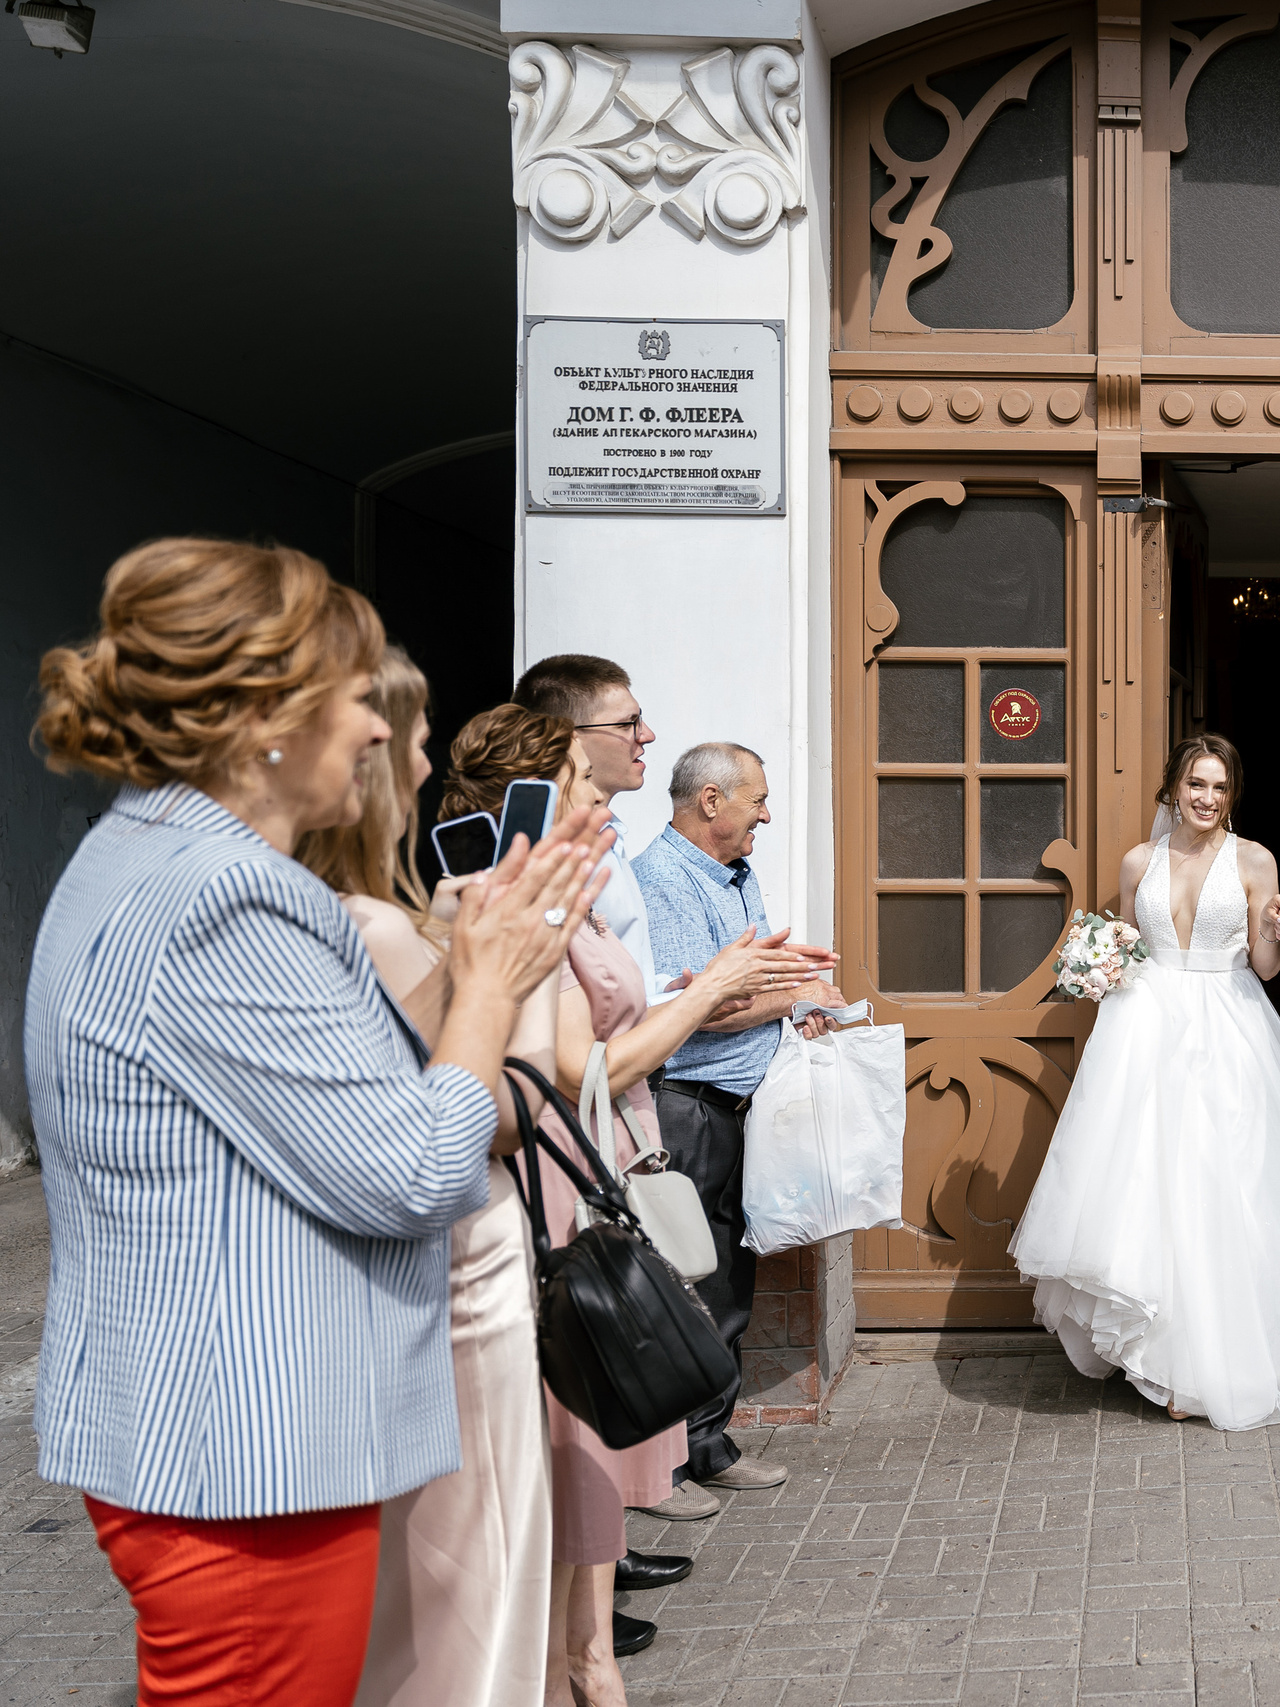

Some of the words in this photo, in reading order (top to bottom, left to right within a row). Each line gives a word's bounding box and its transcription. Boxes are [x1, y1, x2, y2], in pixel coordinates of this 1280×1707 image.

[690, 368, 755, 382] НАСЛЕДИЯ
[578, 380, 675, 393] ФЕДЕРАЛЬНОГО
[676, 381, 739, 394] ЗНАЧЕНИЯ
[566, 406, 615, 426] ДОМ
[618, 406, 635, 423] Г.
[638, 406, 661, 423] Ф.
[665, 406, 745, 424] ФЛЕЕРА
[552, 427, 600, 438] (ЗДАНИЕ
[694, 428, 758, 441] МАГАЗИНА)
[602, 448, 658, 458] ПОСТРОЕНО
[659, 448, 667, 458] В
[669, 449, 686, 458] 1900
[689, 449, 714, 459] ГОДУ
[547, 466, 610, 479] ПОДЛЕЖИТ
[611, 467, 719, 479] ГОСУДАРСТВЕННОЙ
